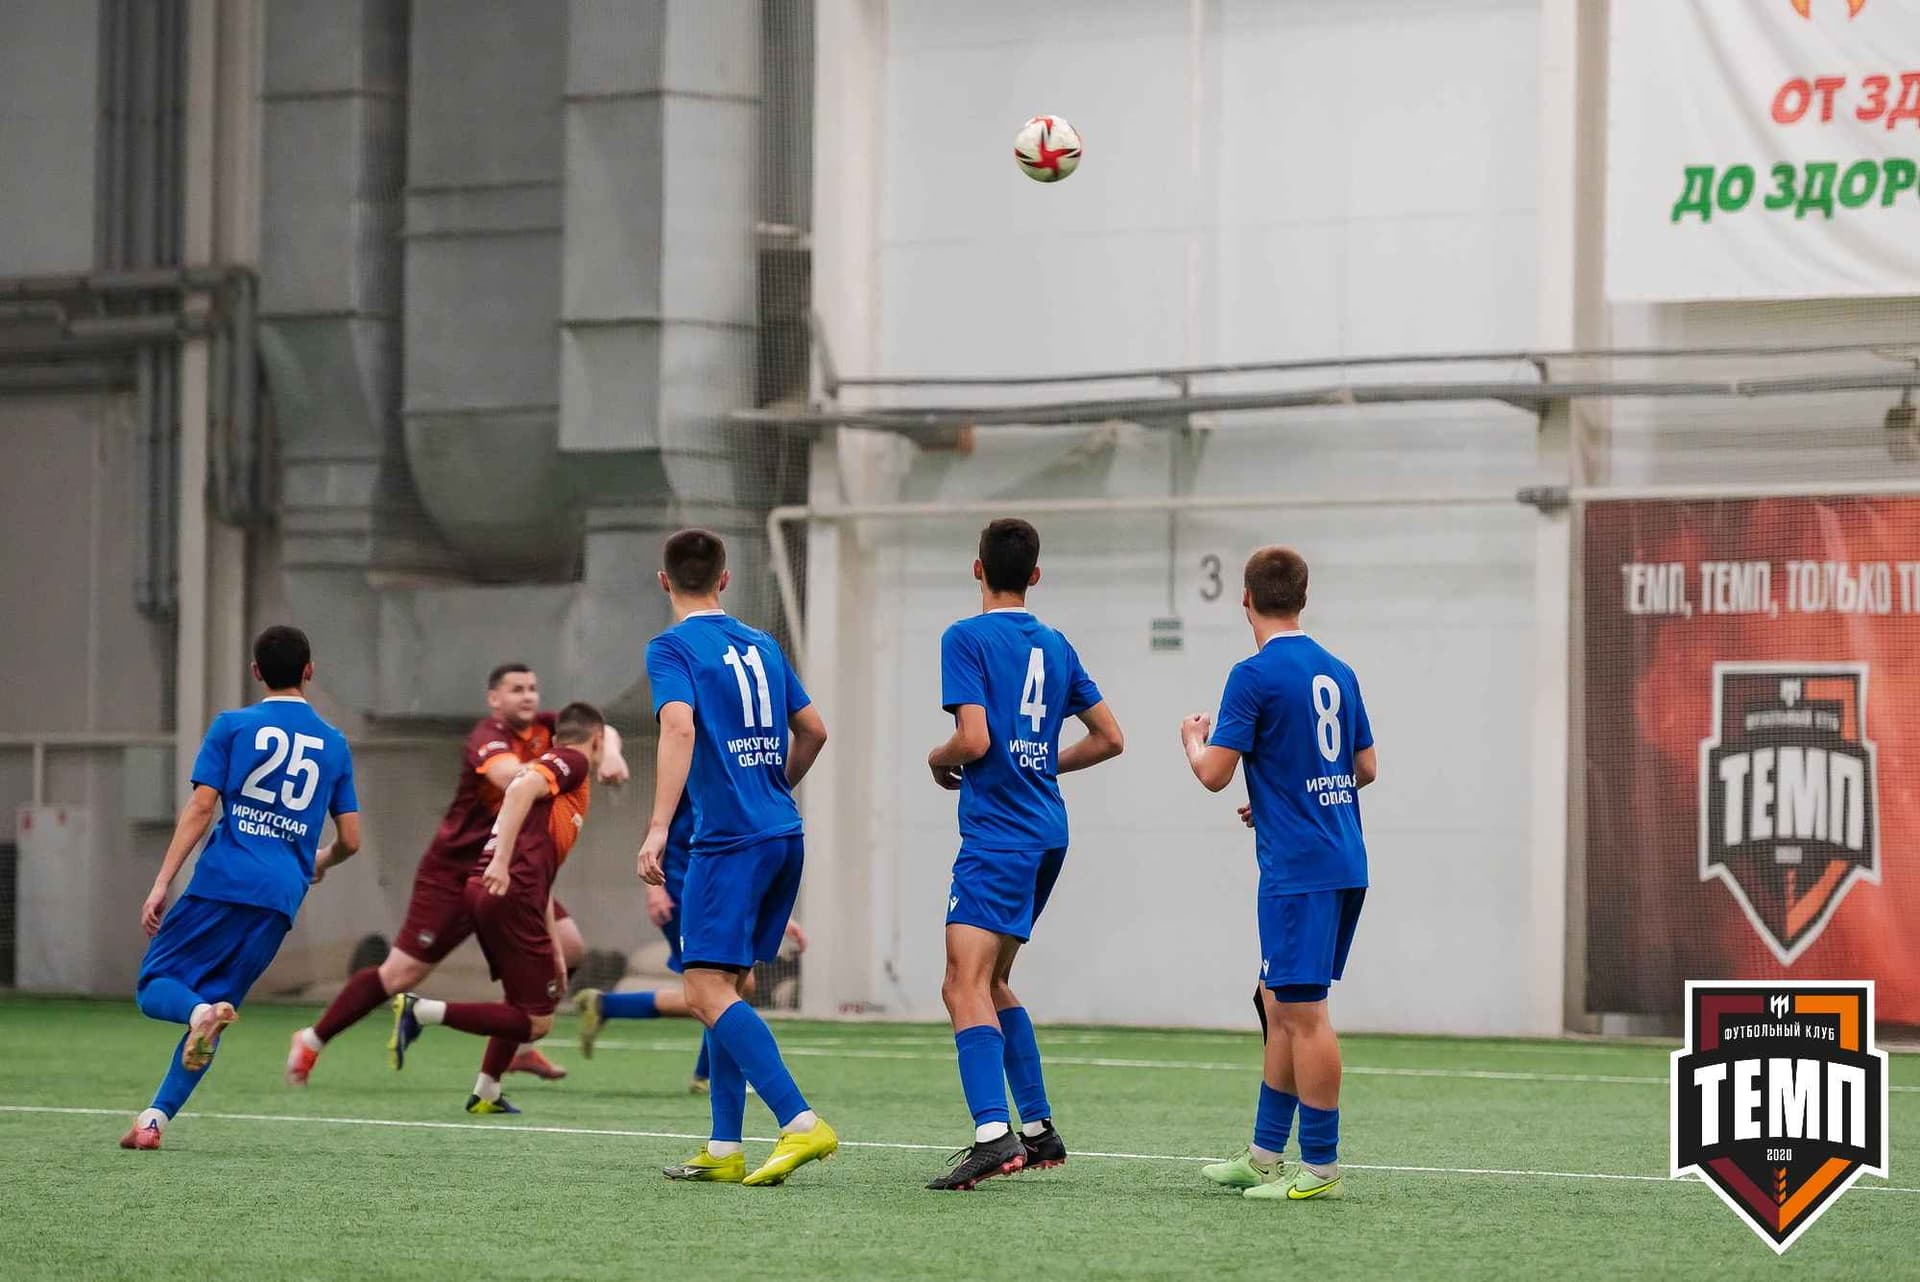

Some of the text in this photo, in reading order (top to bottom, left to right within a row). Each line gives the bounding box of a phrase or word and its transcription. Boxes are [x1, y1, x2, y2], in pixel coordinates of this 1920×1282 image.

[1771, 75, 1846, 124] ОТ
[1671, 157, 1920, 223] ДО ЗДОР
[1200, 553, 1224, 602] 3
[1785, 560, 1891, 615] ТОЛЬКО
[722, 645, 773, 728] 11
[1020, 647, 1047, 733] 4
[1312, 674, 1341, 762] 8
[241, 726, 324, 811] 25
[1719, 746, 1864, 850] ТЕМП
[231, 803, 308, 837] ИРКУТСКАЯ
